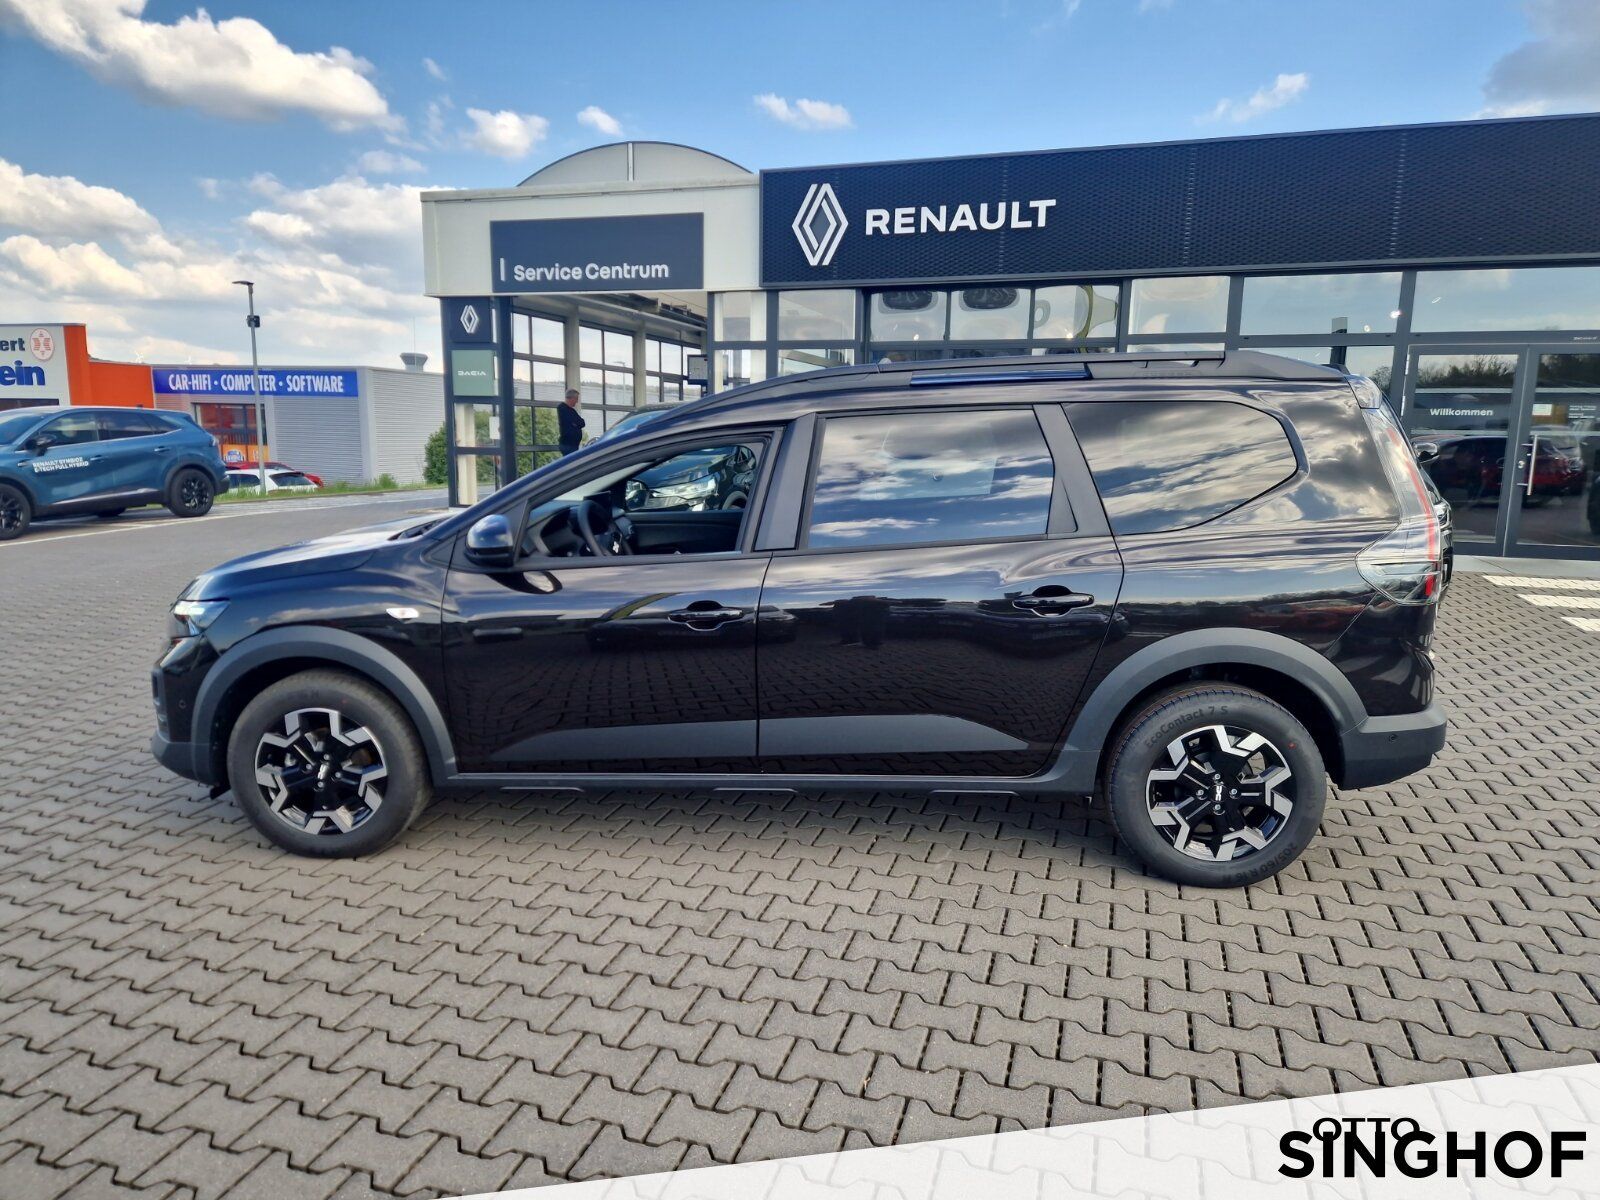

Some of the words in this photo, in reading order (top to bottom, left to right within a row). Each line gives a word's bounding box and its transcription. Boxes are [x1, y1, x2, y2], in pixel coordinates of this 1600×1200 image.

[865, 199, 1057, 236] RENAULT
[513, 262, 583, 282] Service
[585, 262, 669, 280] Centrum
[0, 337, 26, 352] ert
[0, 360, 46, 386] ein
[168, 373, 212, 391] CAR-HIFI
[286, 375, 345, 393] SOFTWARE
[1429, 408, 1494, 416] Willkommen
[1144, 708, 1205, 748] EcoContact
[1208, 706, 1215, 715] 7
[1221, 705, 1228, 715] S
